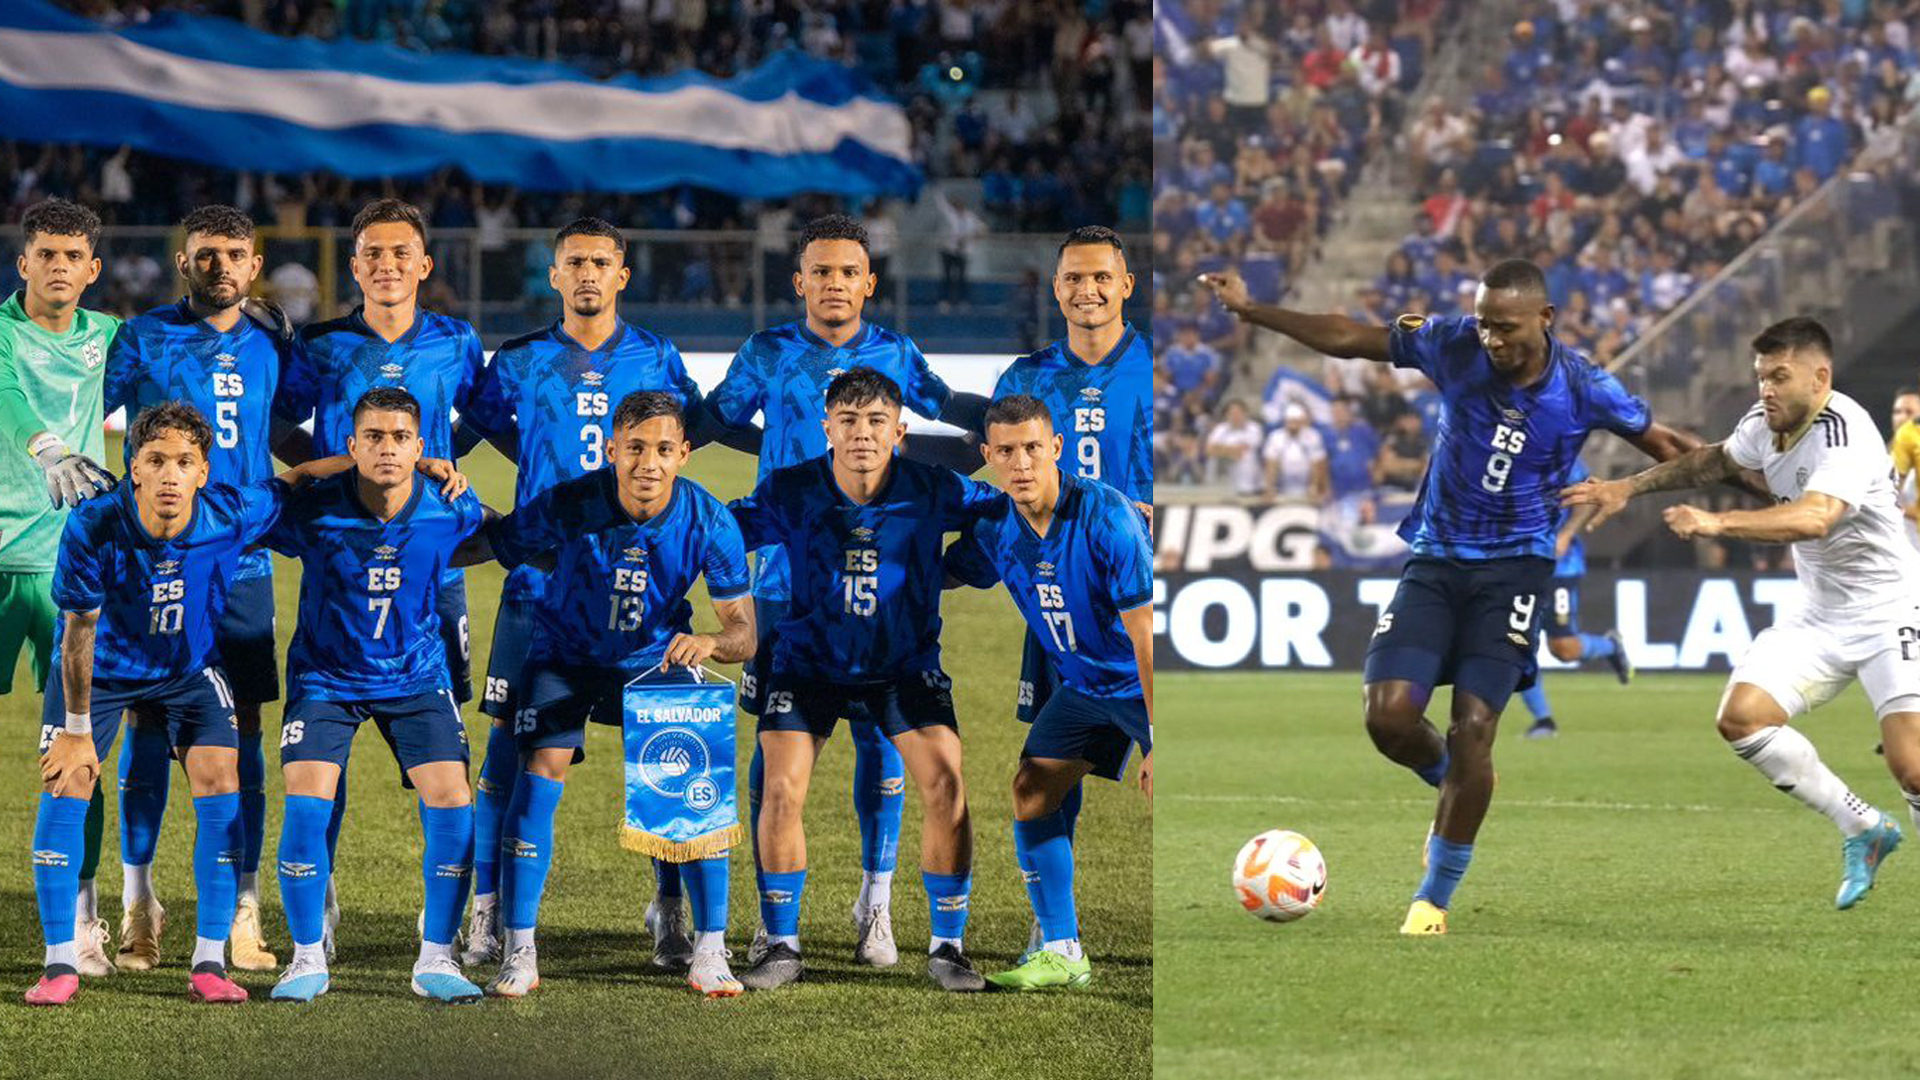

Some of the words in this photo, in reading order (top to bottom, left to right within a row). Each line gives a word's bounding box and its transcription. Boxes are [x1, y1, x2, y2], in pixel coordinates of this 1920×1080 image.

[212, 372, 244, 397] ES
[70, 383, 78, 426] 1
[576, 392, 609, 416] ES
[215, 402, 239, 448] 5
[1075, 408, 1106, 432] ES
[579, 424, 604, 471] 3
[1491, 424, 1526, 455] ES
[1077, 437, 1102, 479] 9
[1482, 454, 1513, 493] 9
[845, 549, 878, 573] ES
[151, 580, 184, 603] ES
[367, 567, 401, 591] ES
[614, 568, 648, 592] ES
[842, 576, 878, 617] 15
[1036, 584, 1065, 609] ES
[149, 604, 184, 635] 10
[368, 597, 393, 639] 7
[608, 594, 644, 632] 13
[1153, 577, 1334, 668] OR
[1508, 594, 1536, 632] 9
[1041, 611, 1078, 653] 17
[485, 676, 509, 702] ES
[765, 690, 794, 715] ES
[514, 708, 538, 735] ES
[637, 709, 651, 723] EL
[654, 707, 722, 723] SALVADOR
[280, 720, 305, 749] ES
[693, 786, 712, 802] ES
